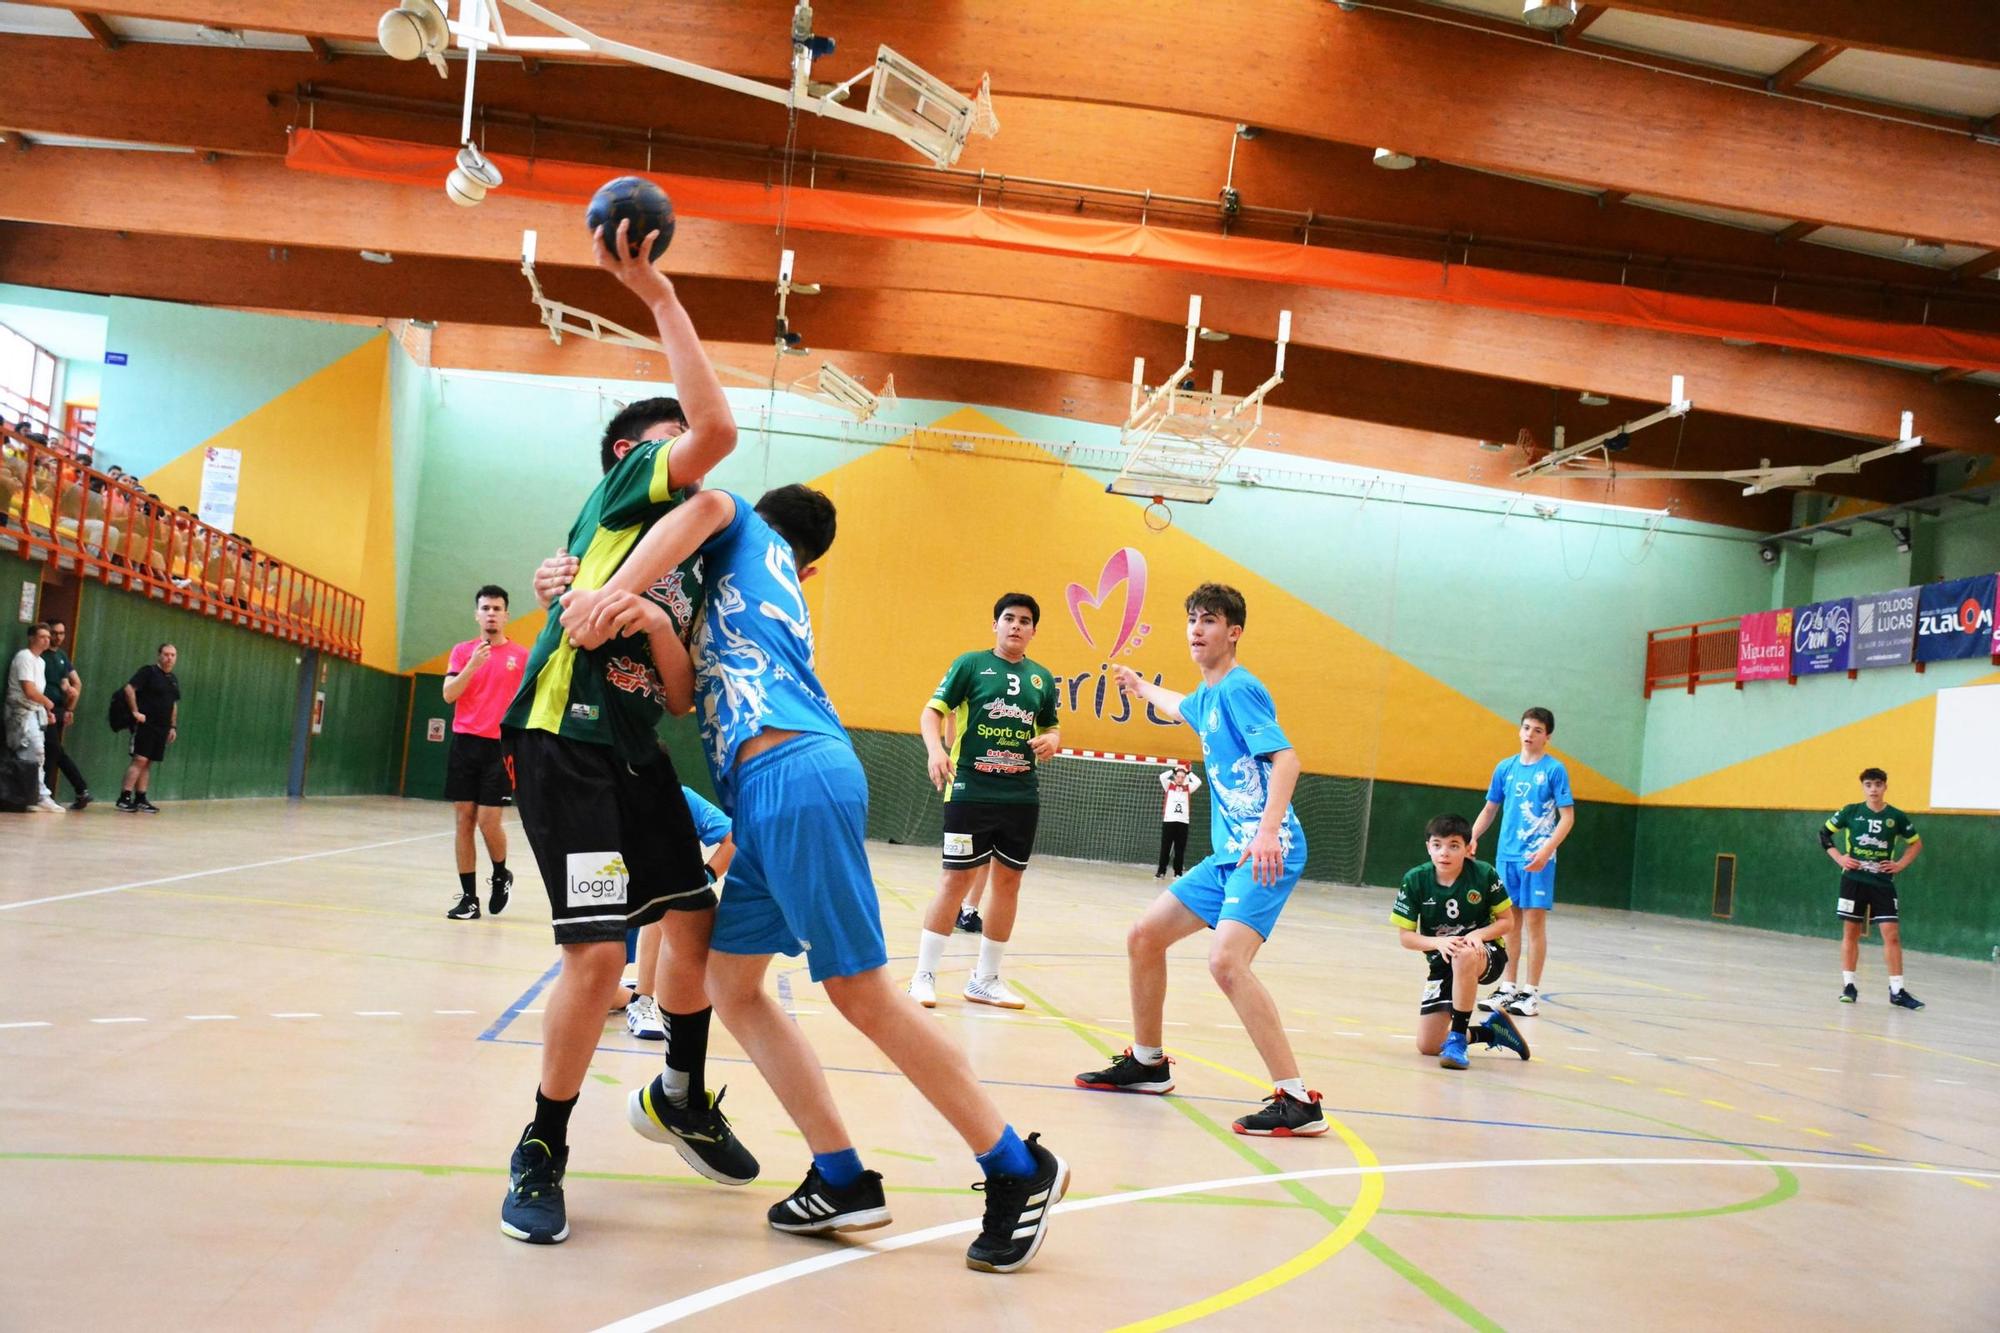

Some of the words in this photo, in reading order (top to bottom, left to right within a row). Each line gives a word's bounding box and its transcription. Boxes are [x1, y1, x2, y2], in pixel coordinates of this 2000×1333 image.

[1877, 596, 1914, 613] TOLDOS
[1877, 613, 1913, 632] LUCAS
[1740, 631, 1750, 643] La
[1006, 673, 1021, 696] 3
[977, 724, 1012, 739] Sport
[1515, 782, 1531, 798] 57
[1867, 819, 1882, 833] 15
[571, 875, 614, 898] loga
[1445, 898, 1460, 919] 8
